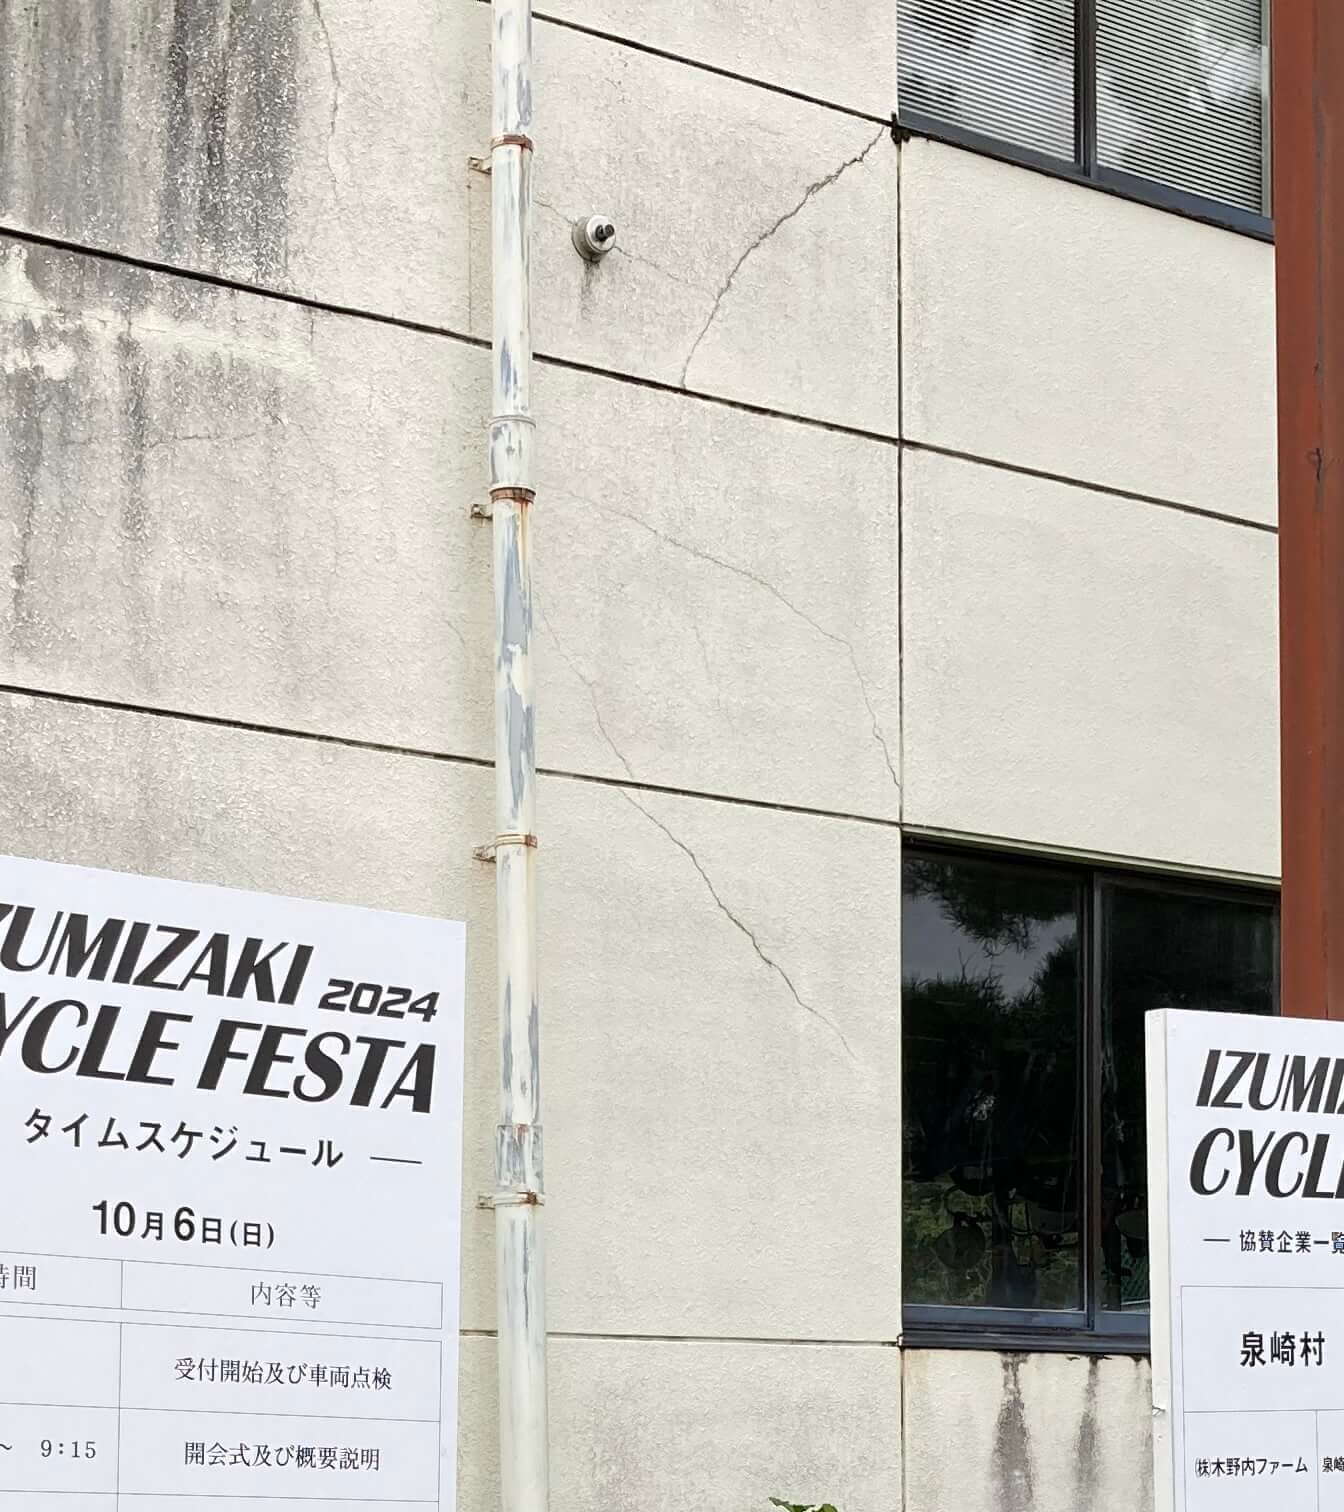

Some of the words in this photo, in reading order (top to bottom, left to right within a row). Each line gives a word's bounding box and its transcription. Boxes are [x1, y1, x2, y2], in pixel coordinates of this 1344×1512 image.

[320, 977, 441, 1022] 2024
[197, 1017, 438, 1114] FESTA
[24, 1107, 344, 1168] タイムスケジュール
[251, 1281, 322, 1310] 内容等
[1239, 1329, 1328, 1368] 泉崎村
[173, 1356, 393, 1391] 受付開始及び車両点検
[184, 1440, 380, 1472] 開会式及び概要説明
